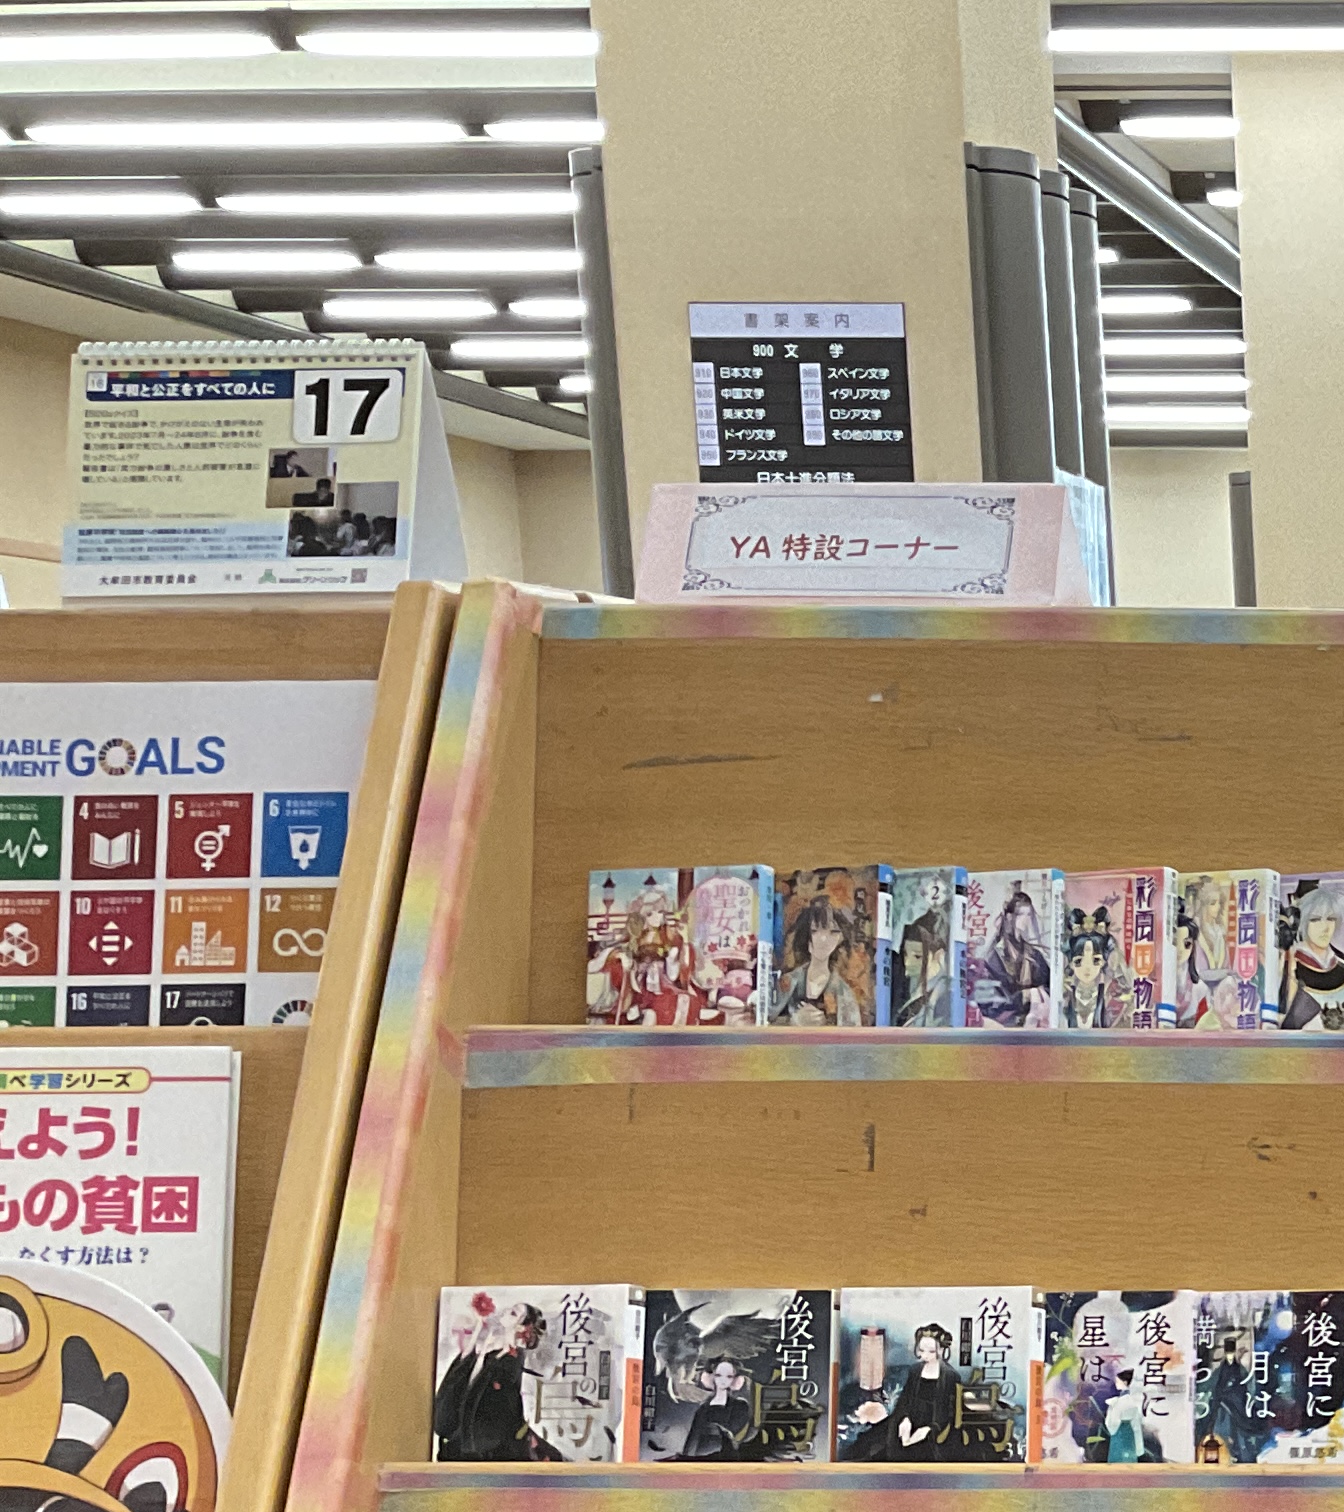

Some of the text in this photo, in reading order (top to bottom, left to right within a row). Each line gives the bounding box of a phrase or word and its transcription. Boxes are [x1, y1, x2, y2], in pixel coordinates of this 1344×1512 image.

[744, 313, 851, 328] 書架案内
[752, 344, 774, 357] 900
[720, 367, 763, 379] 日本文学
[828, 367, 890, 379] スペイン文学
[110, 382, 276, 398] 平和と公正をすべての人に
[720, 388, 765, 399] 中国文学
[829, 389, 891, 400] イタリア文学
[304, 378, 391, 436] 17
[722, 408, 766, 420] 英米文学
[829, 408, 882, 420] ロシア文学
[724, 429, 776, 441] ドイツ文学
[725, 449, 788, 462] フランス文学
[729, 533, 960, 562] YA 特設コーナー
[66, 736, 226, 777] GOALS
[79, 802, 89, 819] 4
[174, 801, 185, 818] 5
[269, 799, 280, 816] 6
[931, 886, 940, 900] 2
[75, 897, 91, 915] 10
[170, 895, 183, 912] 11
[264, 894, 282, 912] 12
[70, 993, 87, 1010] 16
[164, 991, 180, 1009] 17
[1077, 1315, 1110, 1382] 星は
[1136, 1312, 1175, 1418] 後宮に
[1302, 1311, 1341, 1417] 後宮に
[1240, 1351, 1276, 1418] 月は
